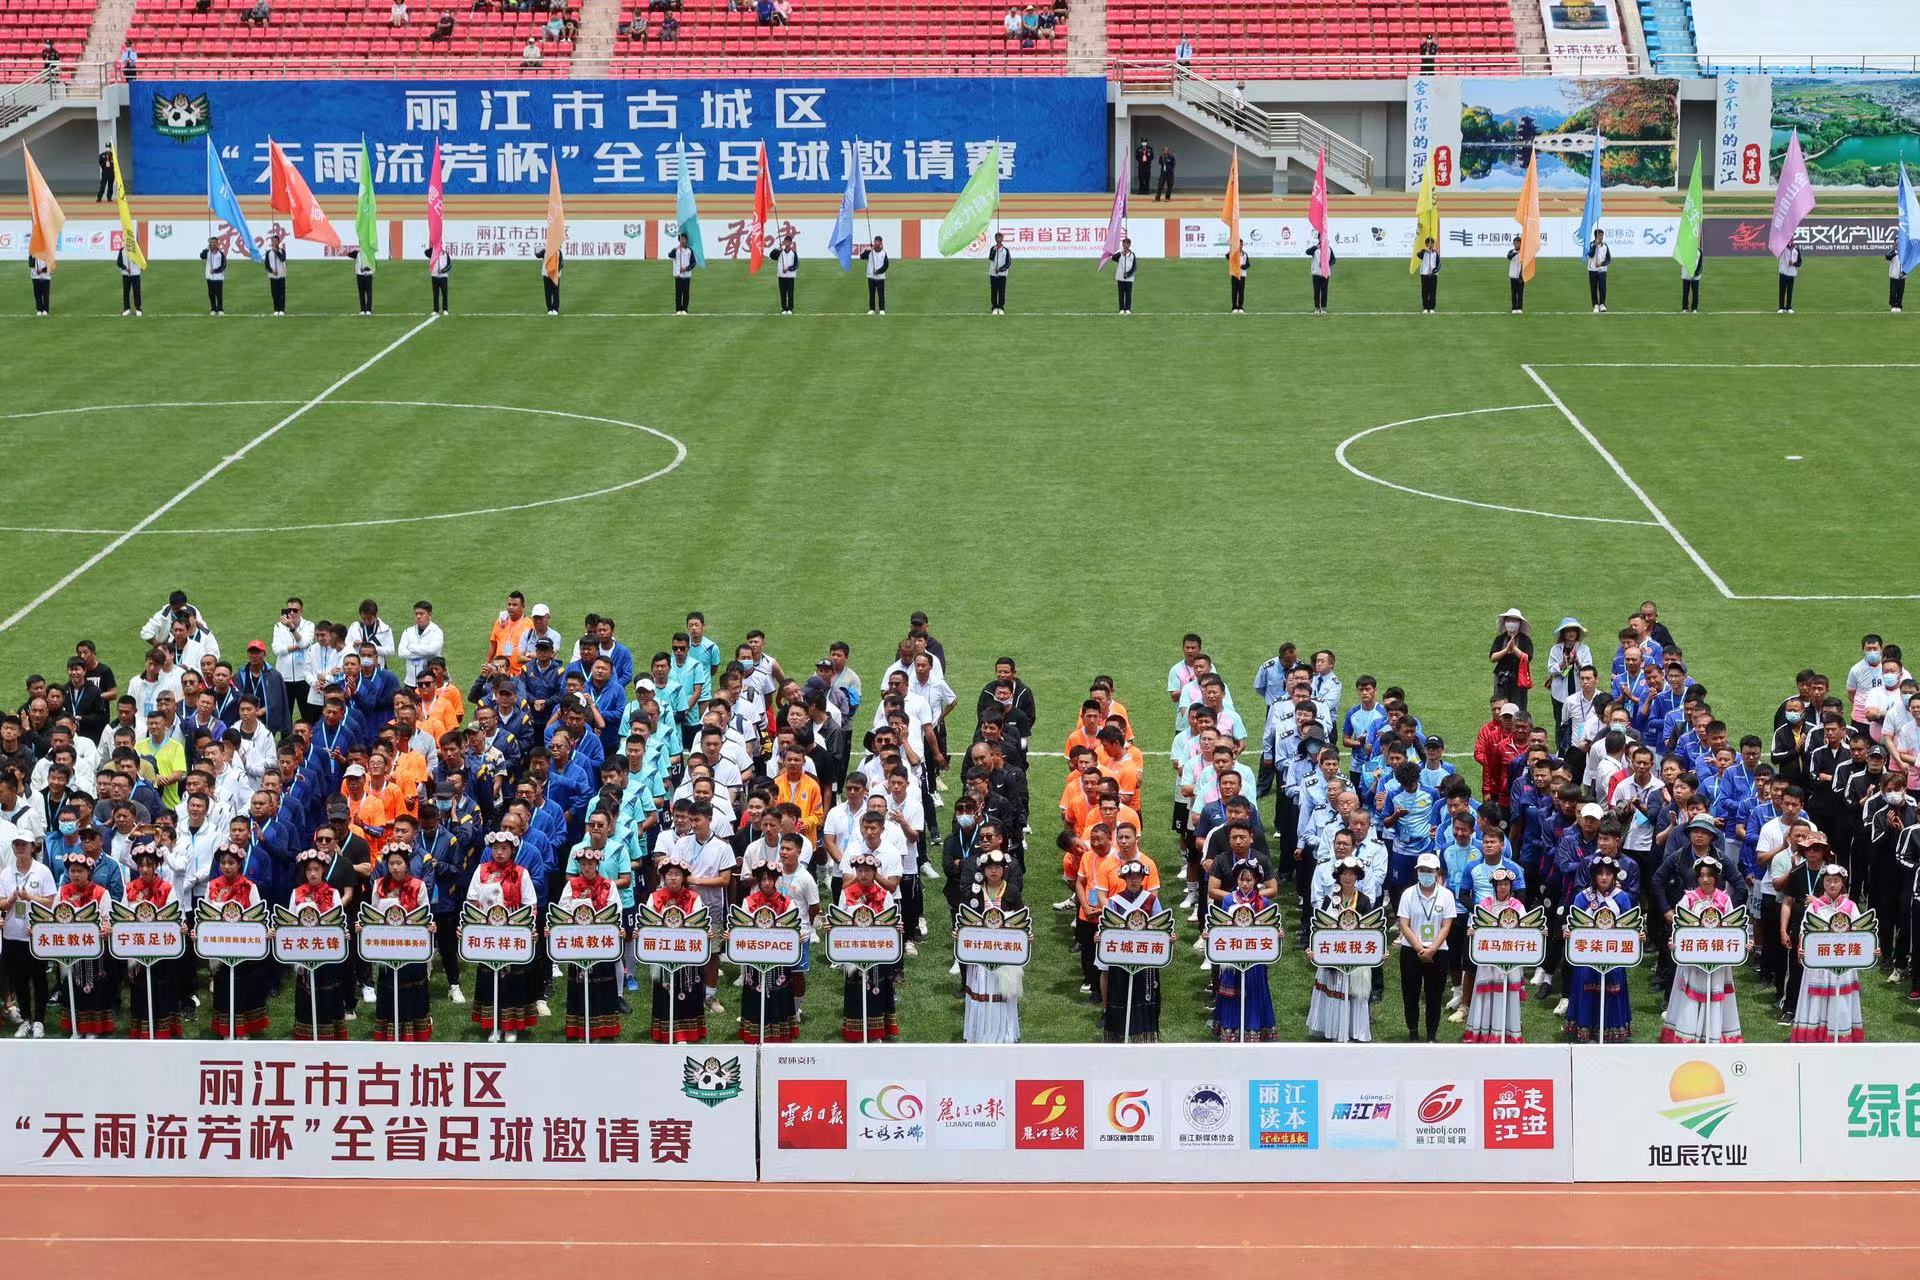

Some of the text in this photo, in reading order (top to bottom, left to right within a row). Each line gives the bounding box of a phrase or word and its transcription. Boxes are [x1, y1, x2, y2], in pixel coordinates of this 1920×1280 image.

[405, 88, 827, 131] 丽江市古城区
[1720, 78, 1739, 184] 舍不得的丽江
[38, 933, 96, 947] 永胜教体
[117, 933, 177, 946] 宁蒗足协
[281, 936, 340, 951] 古农先锋
[467, 936, 527, 950] 和乐祥和
[555, 936, 615, 949] 古城教体
[643, 937, 703, 952] 丽江监狱
[735, 939, 793, 951] 神话SPACE
[833, 939, 894, 950] 丽江市实验学校
[963, 939, 1023, 952] 审计局代表队
[1214, 938, 1273, 951] 合和西安
[1478, 940, 1537, 952] 滇马旅行社
[1575, 940, 1634, 953] 零柒同盟
[1680, 939, 1740, 953] 招商银行
[1106, 941, 1164, 955] 古城西南
[1319, 941, 1378, 954] 古城税务
[1817, 943, 1863, 957] 丽客隆
[777, 1056, 816, 1065] 媒体支持
[199, 1059, 507, 1108] 丽江市古城区
[1258, 1083, 1306, 1105] 丽江
[1258, 1107, 1306, 1130] 读本
[1331, 1103, 1392, 1120] 丽江网
[1493, 1091, 1520, 1142] 丽江
[859, 1125, 925, 1142] 七彩云端
[1179, 1133, 1235, 1142] 丽江新媒体协会
[1415, 1125, 1466, 1136] weibolj.com
[15, 1112, 693, 1164] “天雨流芳杯”全省足球邀请赛
[1416, 1135, 1467, 1145] 丽江同城网
[1648, 1144, 1748, 1167] 旭辰农业
